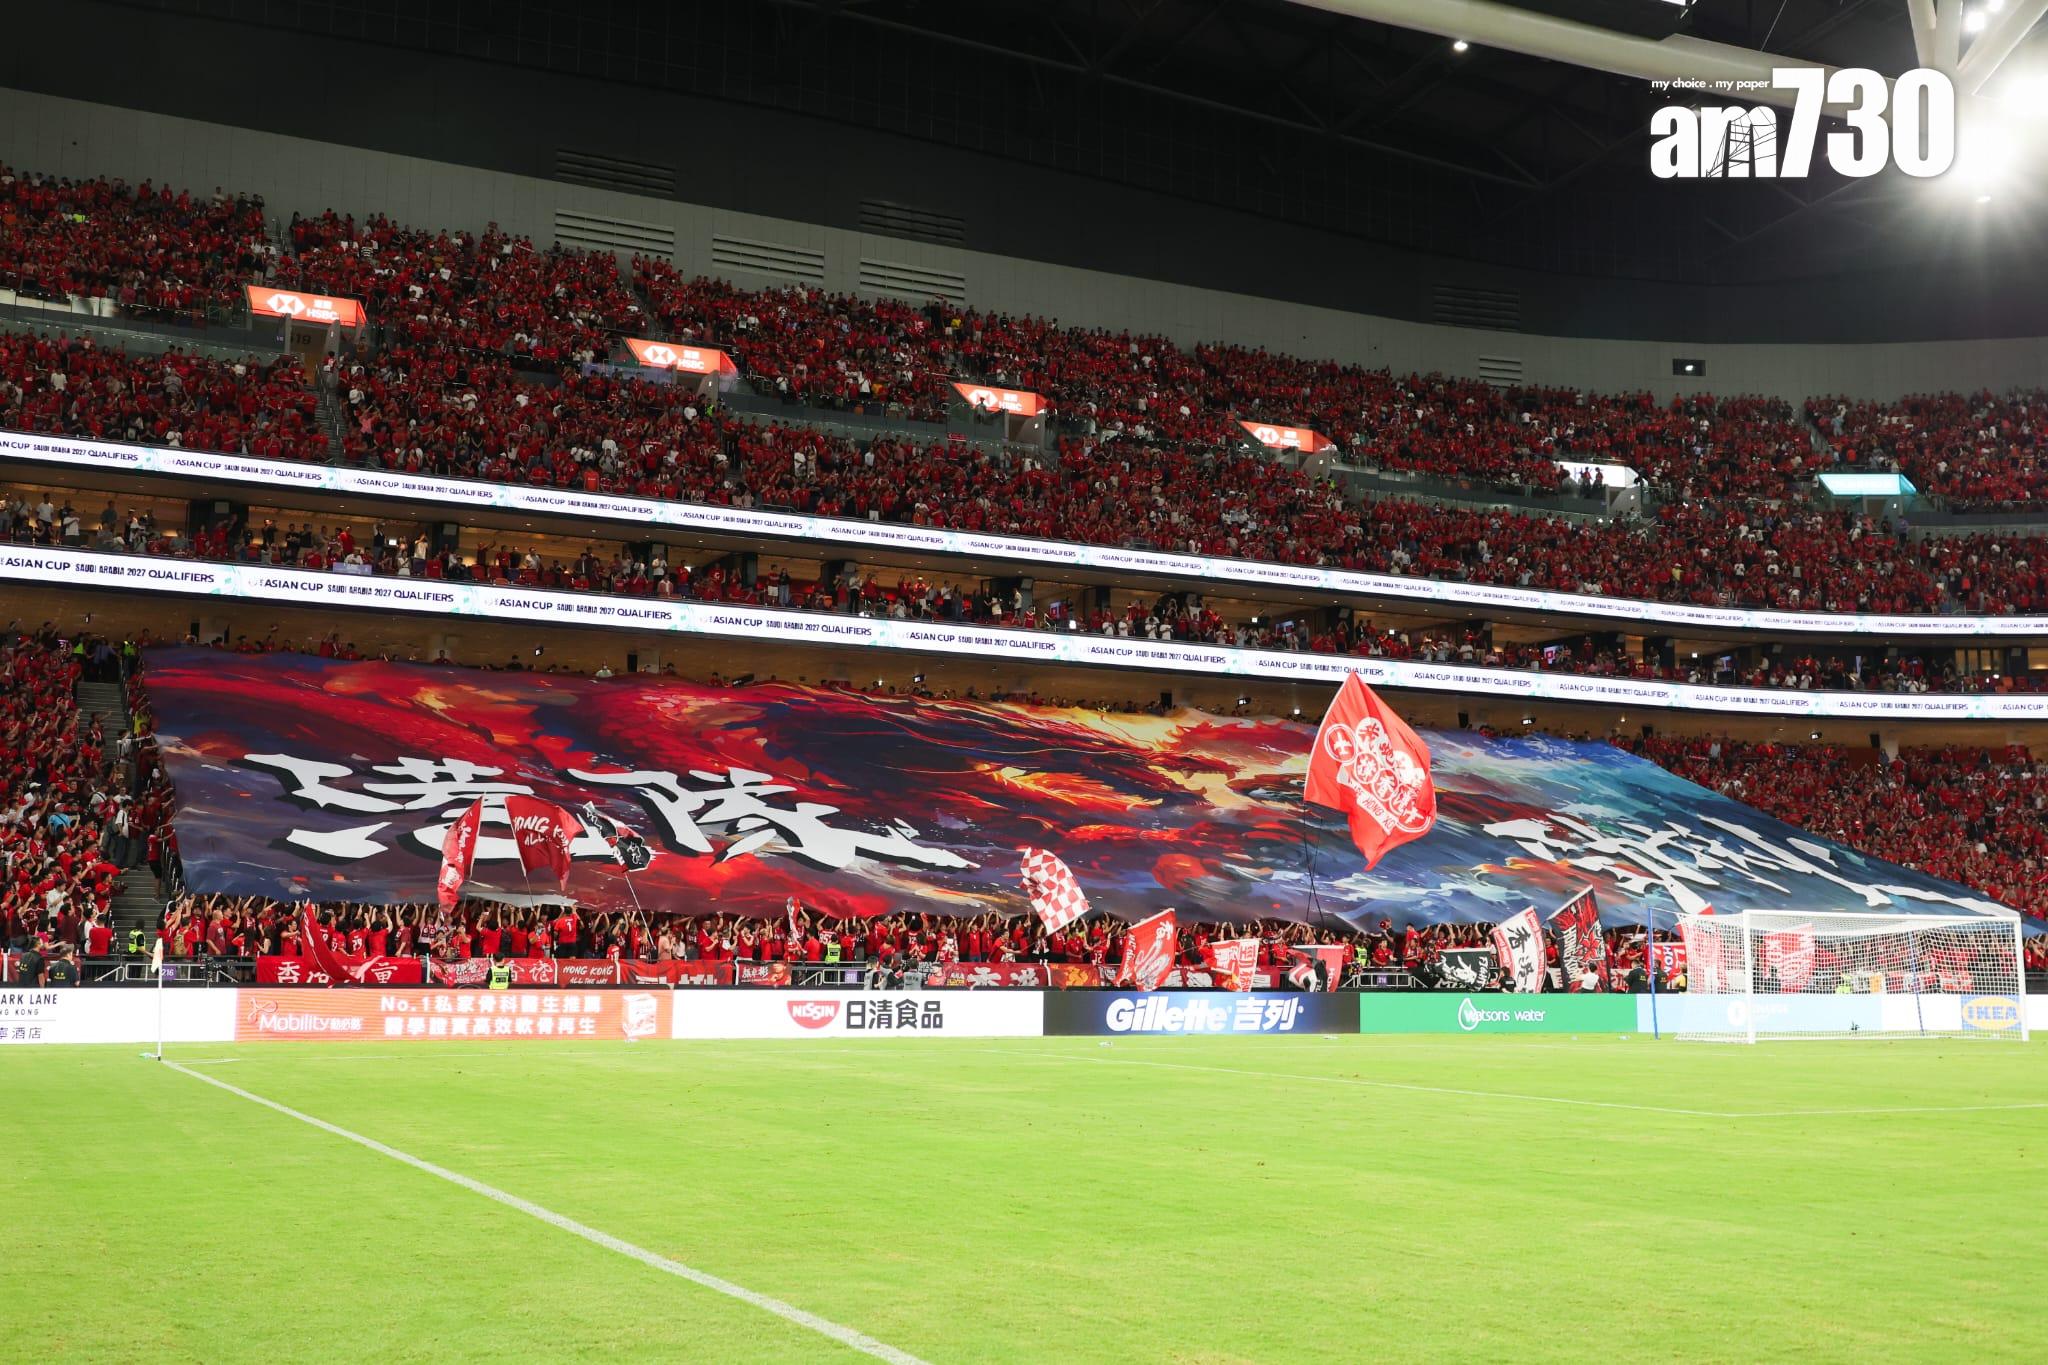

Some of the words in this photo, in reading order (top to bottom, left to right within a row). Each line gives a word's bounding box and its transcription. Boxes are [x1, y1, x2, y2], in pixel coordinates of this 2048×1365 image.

[88, 450, 138, 461] QUALIFIERS
[176, 459, 203, 467] ASIAN
[275, 469, 322, 480] QUALIFIERS
[357, 478, 382, 486] ASIAN
[6, 558, 44, 568] ASIAN
[46, 561, 70, 571] CUP
[126, 568, 145, 576] 2027
[148, 570, 214, 583] QUALIFIERS
[264, 579, 299, 589] ASIAN
[301, 582, 323, 591] CUP
[393, 590, 454, 602] QUALIFIERS
[500, 599, 531, 608] ASIAN
[533, 601, 553, 610] CUP
[617, 608, 672, 620] QUALIFIERS
[714, 616, 743, 625] ASIAN
[744, 618, 763, 627] CUP
[562, 965, 587, 976] HONG
[30, 994, 58, 1005] LANE
[792, 1002, 835, 1020] NISSIN
[846, 998, 944, 1030] 日清食品
[1106, 996, 1229, 1032] Gillette
[1232, 996, 1299, 1031] 吉列
[1513, 1008, 1545, 1022] water
[1967, 1006, 2017, 1020] IKEA
[259, 1014, 330, 1032] Mobility
